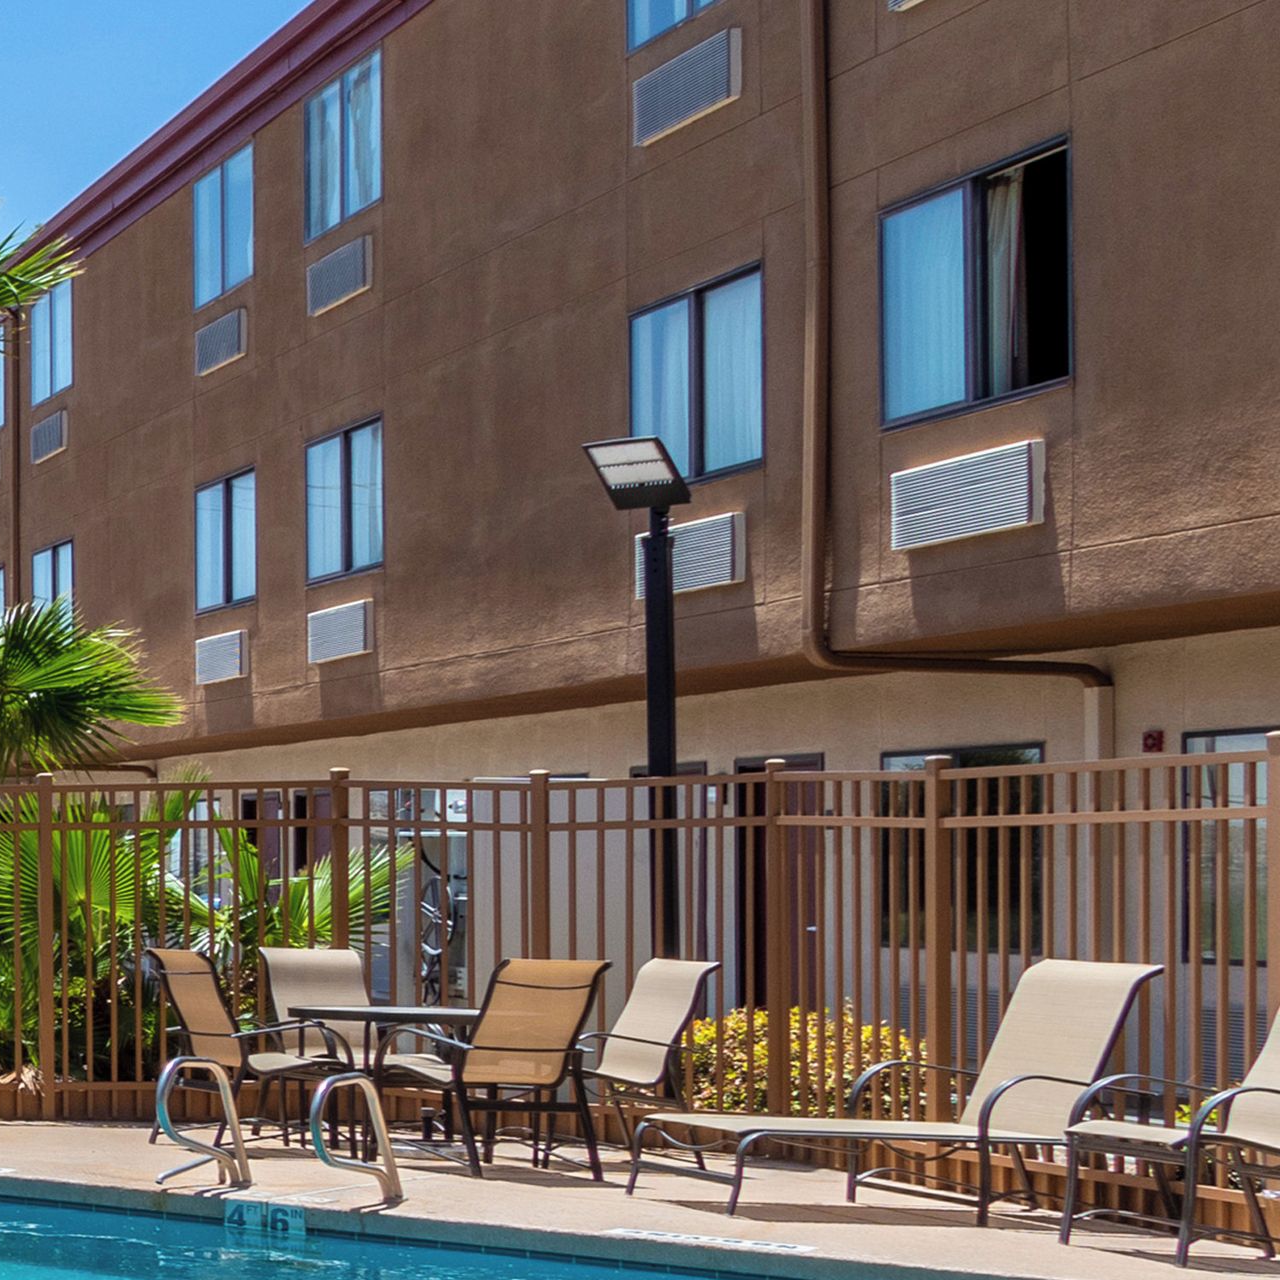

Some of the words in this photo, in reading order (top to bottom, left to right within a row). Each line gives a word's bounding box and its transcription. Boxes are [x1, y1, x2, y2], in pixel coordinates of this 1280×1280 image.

[226, 1204, 246, 1227] 4
[247, 1205, 259, 1216] FT
[270, 1207, 289, 1231] 6
[290, 1210, 303, 1219] IN
